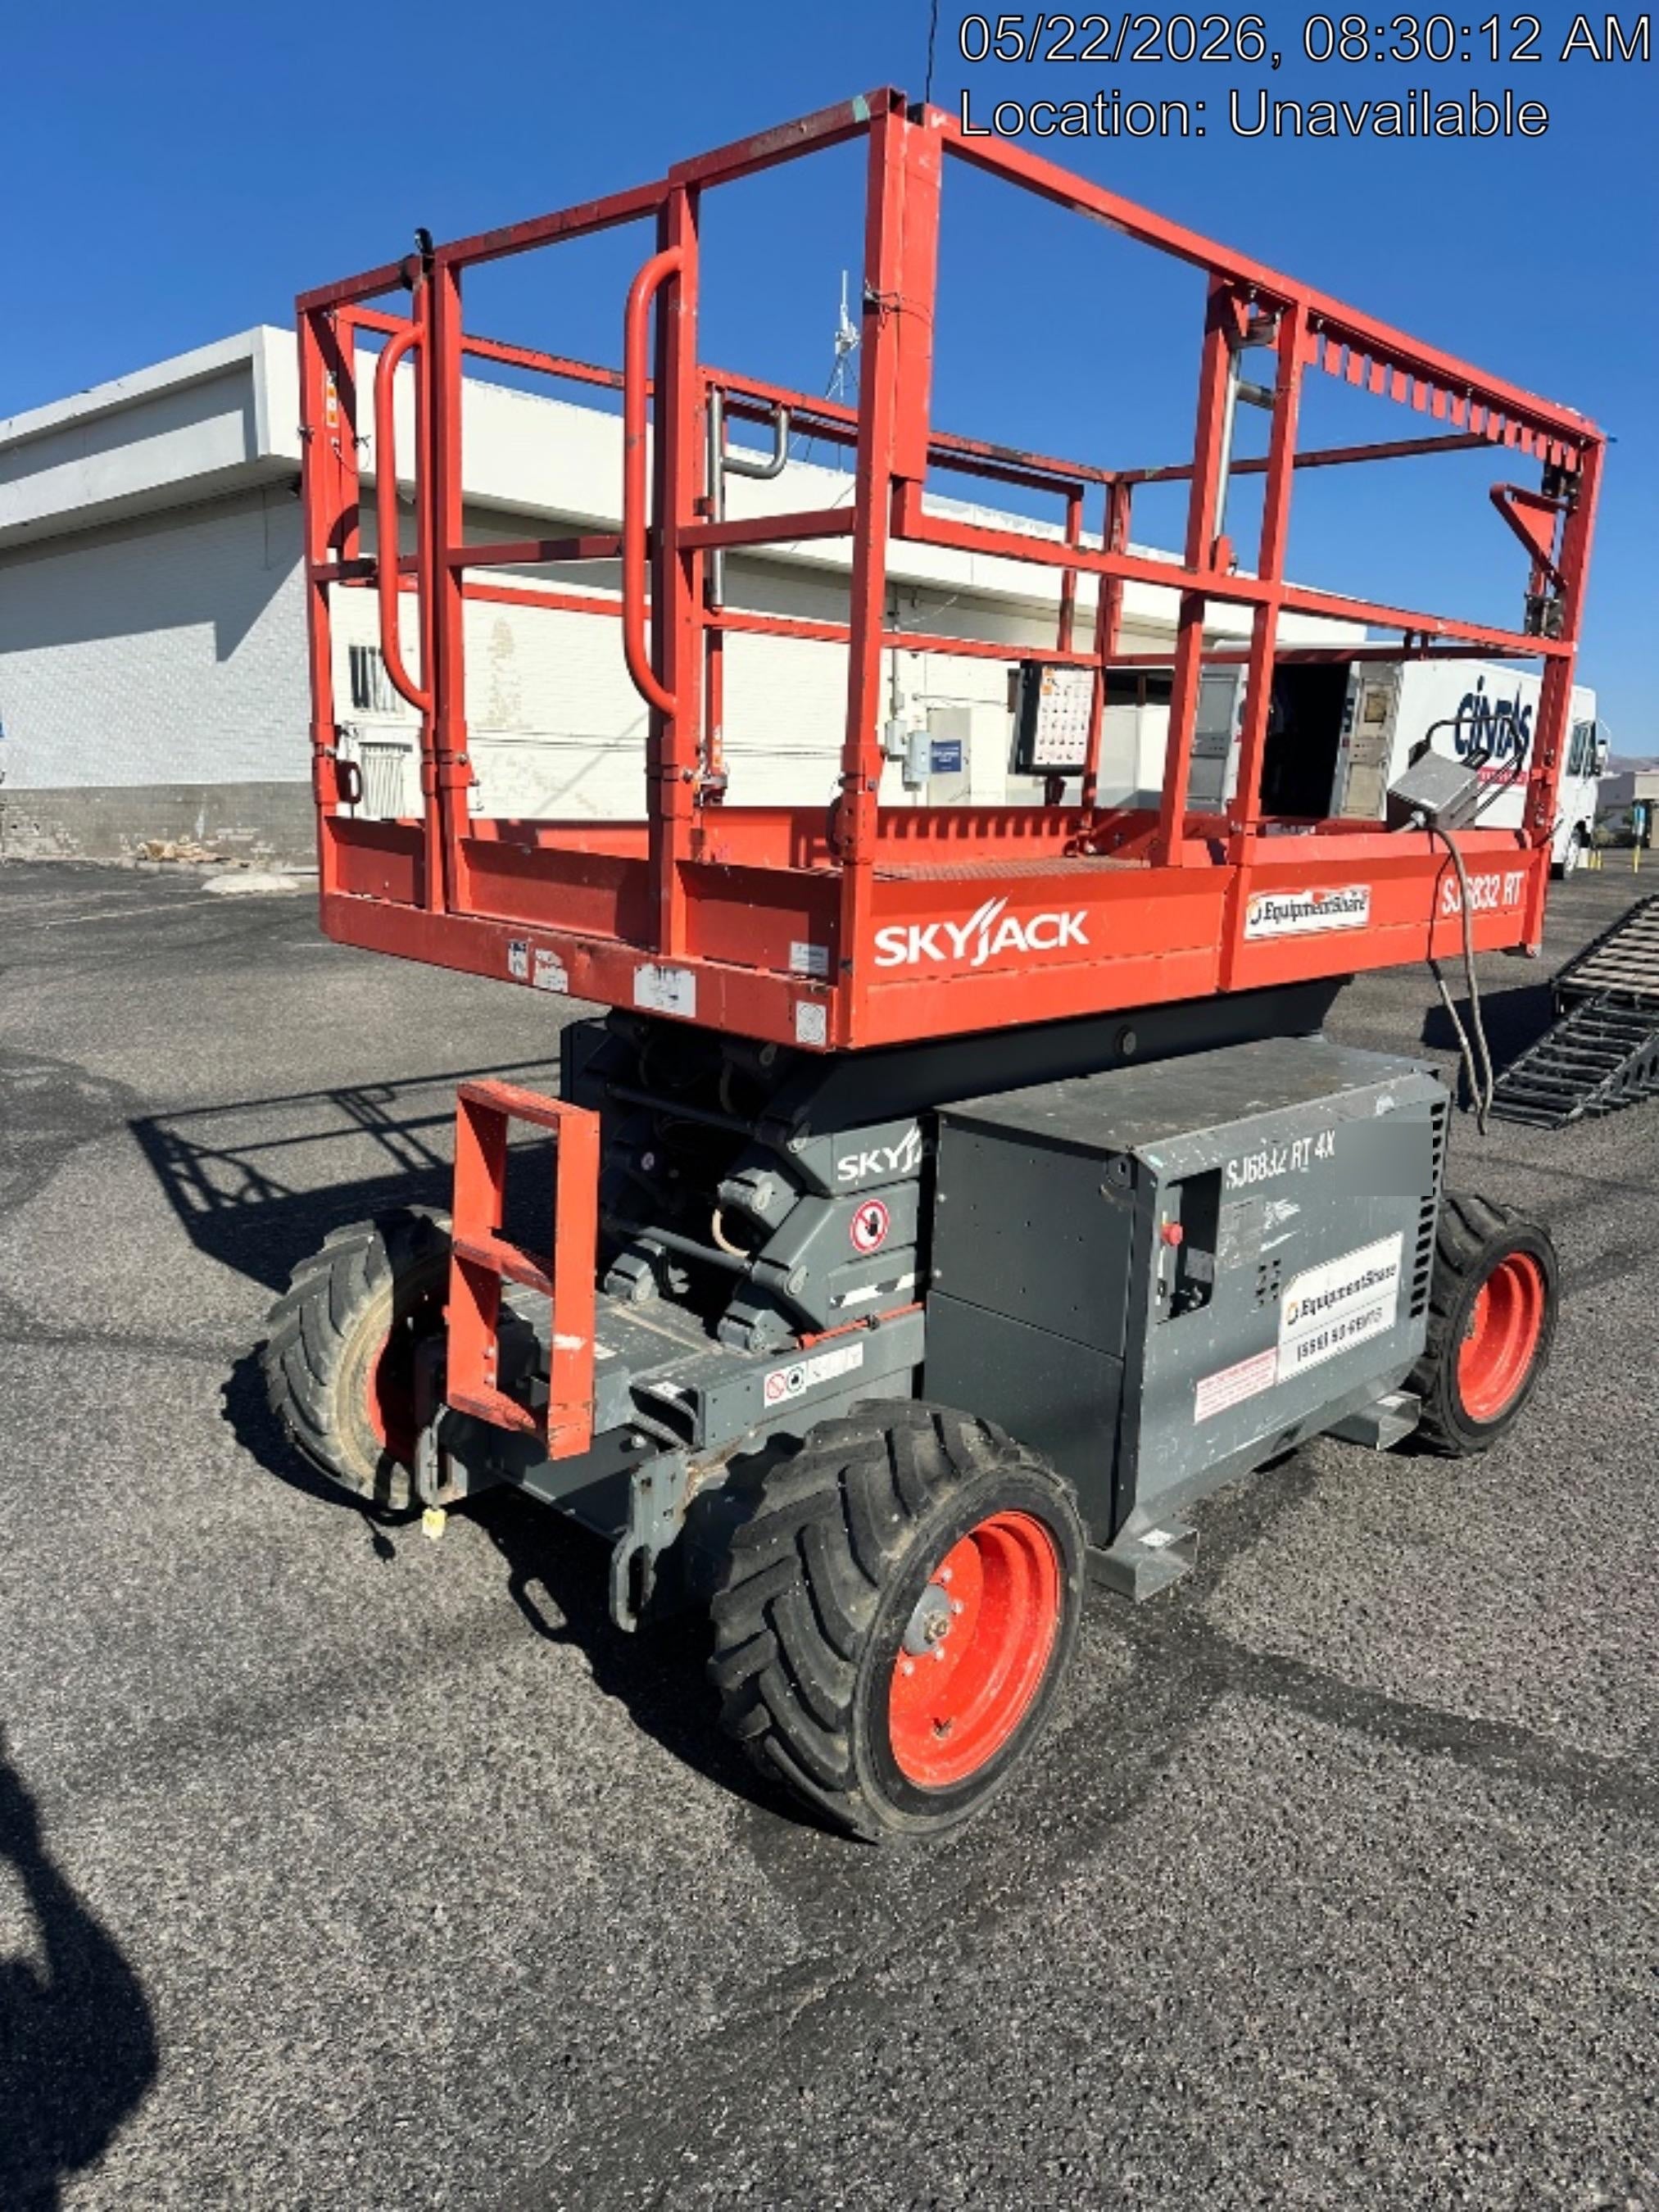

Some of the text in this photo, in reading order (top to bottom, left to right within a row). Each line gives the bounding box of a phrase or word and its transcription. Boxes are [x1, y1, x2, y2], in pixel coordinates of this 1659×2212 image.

[1502, 870, 1525, 905] RT
[873, 896, 1090, 967] SKYJACK
[1290, 1136, 1312, 1170] RT
[1300, 1264, 1397, 1317] EquipmentShare
